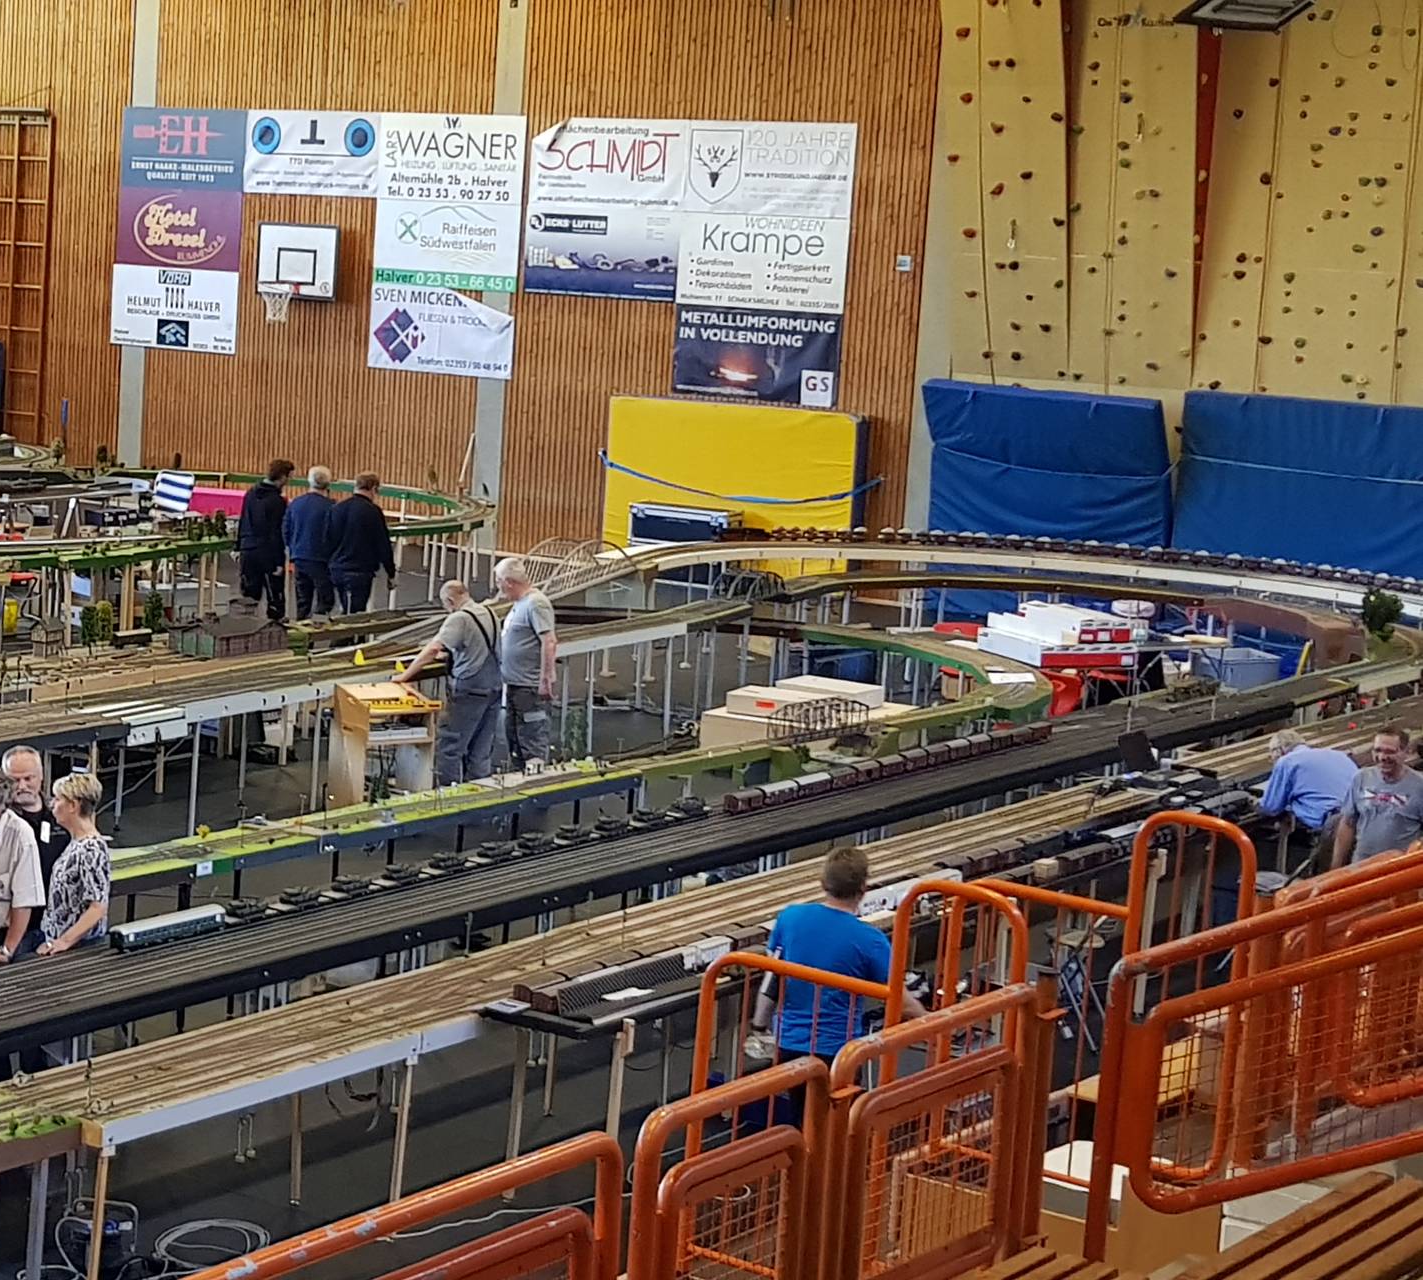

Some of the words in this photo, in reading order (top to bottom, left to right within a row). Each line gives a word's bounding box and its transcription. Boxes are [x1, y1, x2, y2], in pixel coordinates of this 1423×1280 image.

[159, 115, 209, 155] EH
[746, 130, 778, 147] 120
[784, 131, 851, 149] JAHRE
[384, 130, 398, 168] LARS
[396, 130, 517, 161] WAGNER
[131, 161, 153, 170] ERNST
[400, 159, 436, 170] HEIZUNG
[442, 161, 477, 172] LÜFTUNG
[746, 148, 851, 167] TRADITION
[146, 171, 179, 181] QUALITÄT
[181, 172, 196, 181] SEIT
[389, 172, 444, 186] Altemühle
[447, 174, 461, 186] 2b
[471, 175, 508, 188] Halver
[637, 174, 665, 183] GmbH
[387, 185, 404, 197] Tel.
[407, 186, 414, 197] 0
[418, 187, 431, 198] 23
[435, 187, 449, 199] 53
[459, 188, 474, 200] 90
[477, 189, 492, 201] 27
[495, 190, 510, 202] 50
[144, 203, 197, 227] Hotel
[441, 222, 497, 237] Raiffeisen
[744, 217, 826, 232] WOHNIDEEN
[419, 236, 496, 252] Südwestfalen
[702, 223, 825, 261] Krampe
[696, 257, 734, 267] Gardinen
[773, 261, 831, 273] Fertigparkett
[375, 269, 414, 283] Halver
[416, 273, 424, 284] 0
[426, 274, 441, 285] 23
[444, 275, 459, 286] 53
[487, 278, 503, 290] 45
[505, 279, 514, 290] 0
[695, 268, 752, 279] Dekorationen
[773, 273, 833, 284] Sonnenschutz
[694, 279, 752, 291] Teppichböden
[771, 284, 810, 295] Polsterei
[127, 296, 161, 308] HELMUT
[187, 301, 221, 312] HALVER
[374, 287, 407, 302] SVEN
[409, 290, 468, 307] MICKEN
[680, 310, 836, 334] METALLUMFORMUNG
[679, 326, 695, 339] IN
[700, 327, 803, 348] VOLLENDUNG
